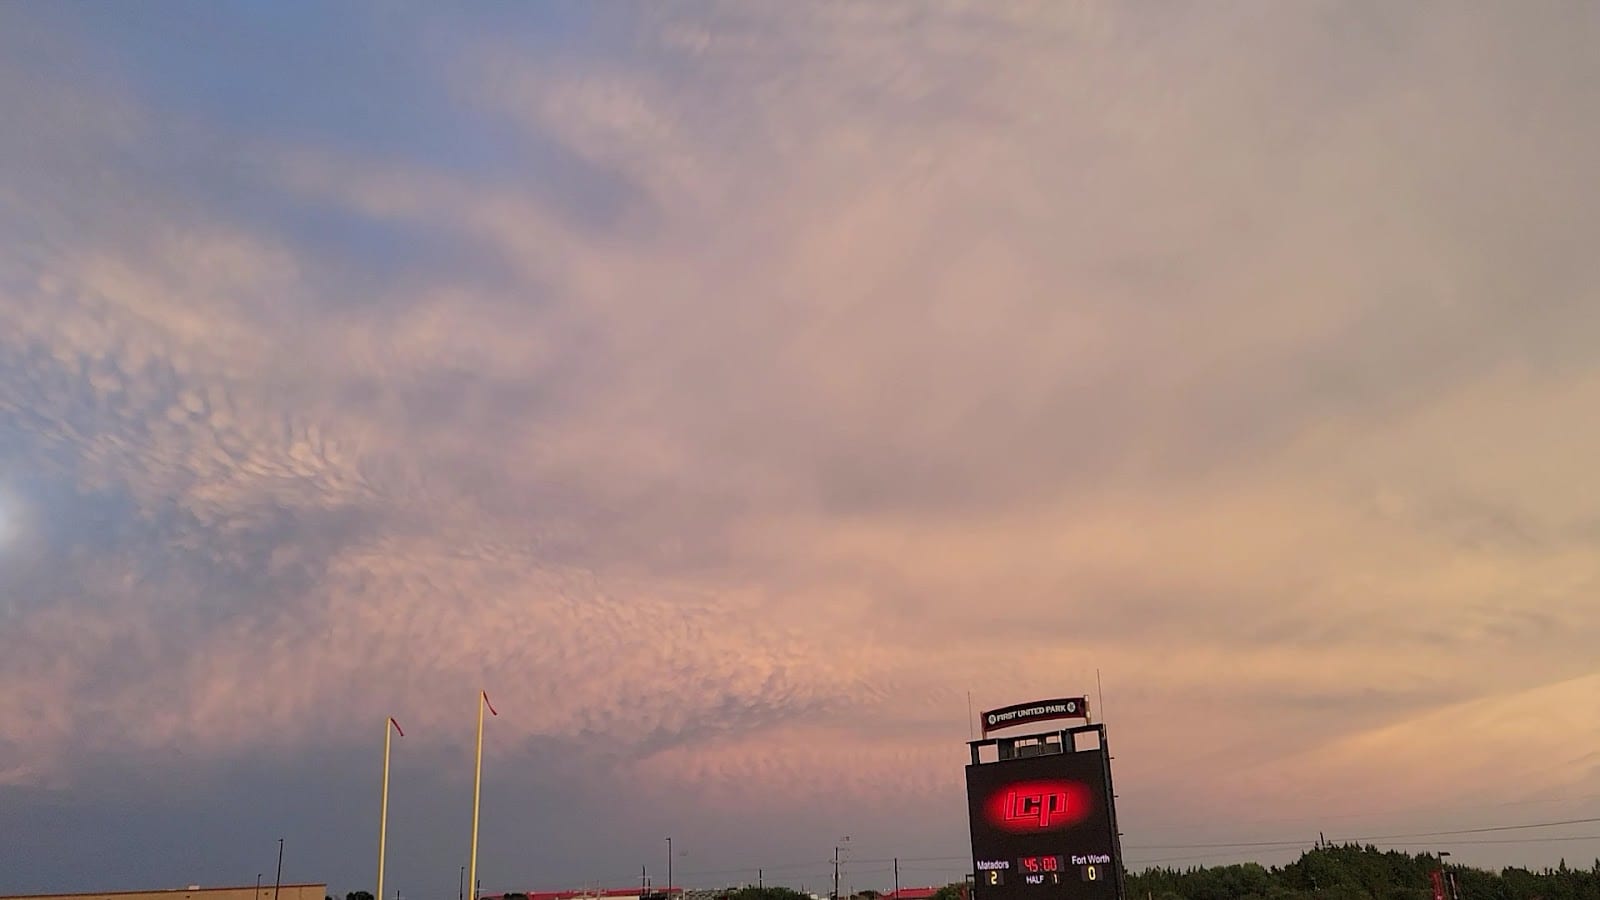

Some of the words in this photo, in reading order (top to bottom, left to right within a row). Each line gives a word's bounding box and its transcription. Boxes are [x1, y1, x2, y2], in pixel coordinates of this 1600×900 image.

[997, 712, 1017, 722] FIRST
[1017, 706, 1045, 717] UNITED
[1045, 704, 1067, 714] PARK
[977, 860, 1010, 870] Matadors
[1024, 857, 1057, 872] 45:00
[1071, 855, 1087, 865] Fort
[1087, 854, 1110, 864] Worth
[990, 871, 998, 885] 2
[1026, 874, 1045, 884] HALF
[1053, 873, 1059, 884] 1
[1088, 866, 1096, 881] 0
